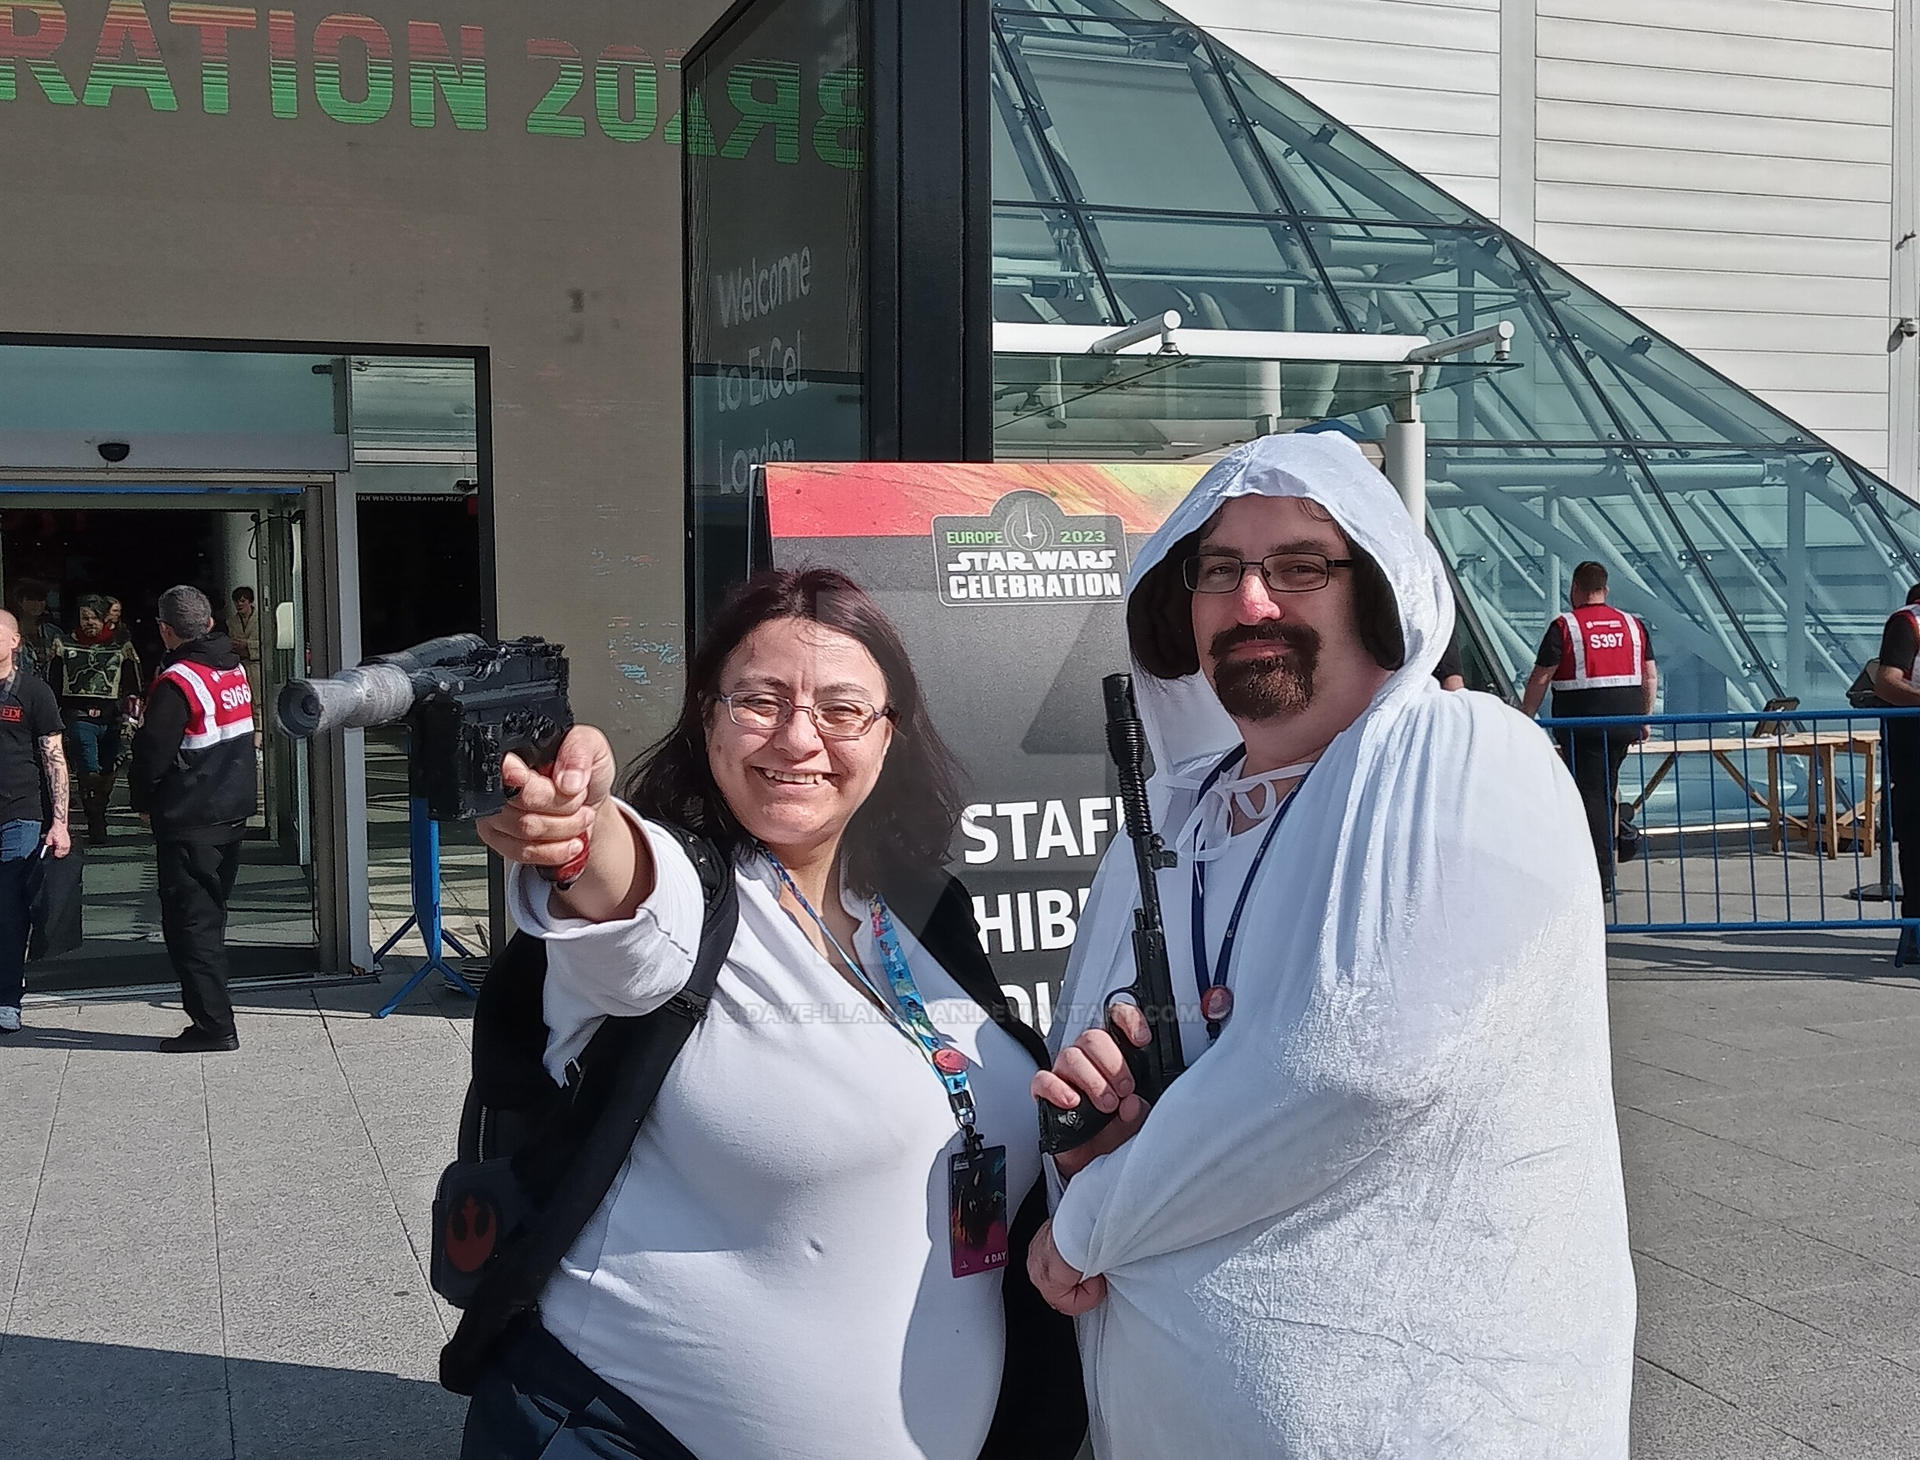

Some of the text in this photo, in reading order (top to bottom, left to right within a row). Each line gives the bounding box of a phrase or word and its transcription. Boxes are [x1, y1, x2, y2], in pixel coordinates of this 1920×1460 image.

[0, 0, 487, 130] RATION
[716, 246, 811, 328] Welcome
[716, 361, 741, 412] to
[946, 530, 1106, 544] EUROPE 2023
[947, 550, 1116, 572] STAR WARS
[949, 572, 1122, 600] CELEBRATION
[1590, 632, 1624, 649] S397
[991, 1252, 1006, 1262] DAY
